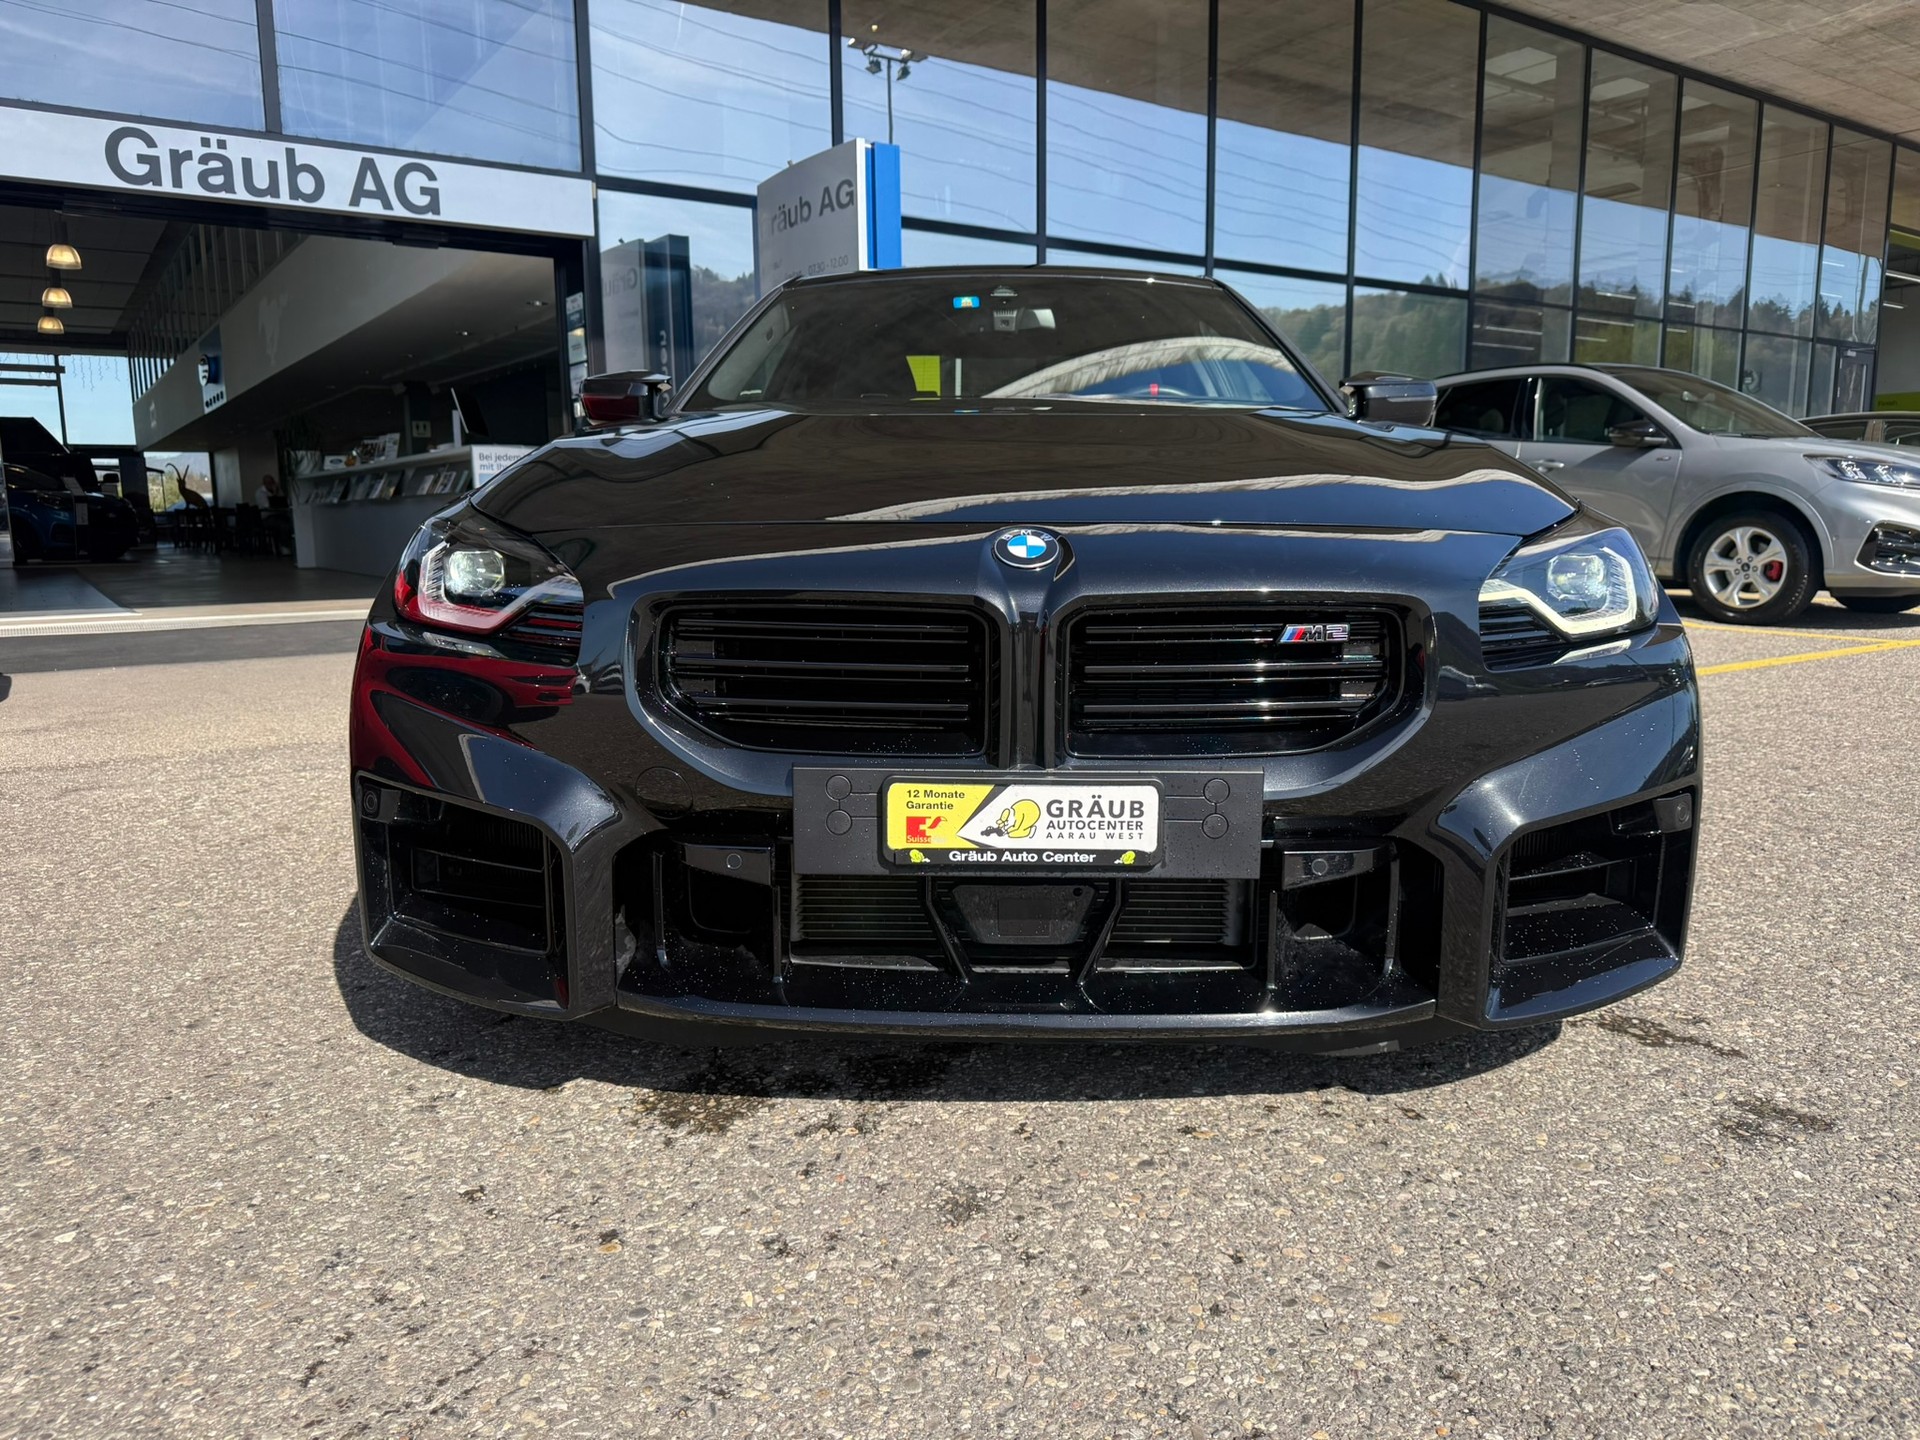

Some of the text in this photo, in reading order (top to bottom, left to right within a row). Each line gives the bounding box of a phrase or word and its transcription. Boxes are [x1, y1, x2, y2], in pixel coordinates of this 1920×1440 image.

[105, 126, 441, 216] Gräub AG
[765, 178, 855, 237] räub AG
[479, 452, 492, 462] Bei
[480, 463, 494, 471] mit
[1001, 529, 1054, 542] BMW
[1280, 623, 1349, 643] M2
[906, 789, 965, 799] 12 Monate
[906, 801, 954, 810] Garantie
[1046, 794, 1145, 819] GRÄUB
[1046, 820, 1144, 831] AUTOCENTER
[1046, 832, 1144, 840] AARAU WEST
[948, 850, 1097, 863] Gräub Auto Center
